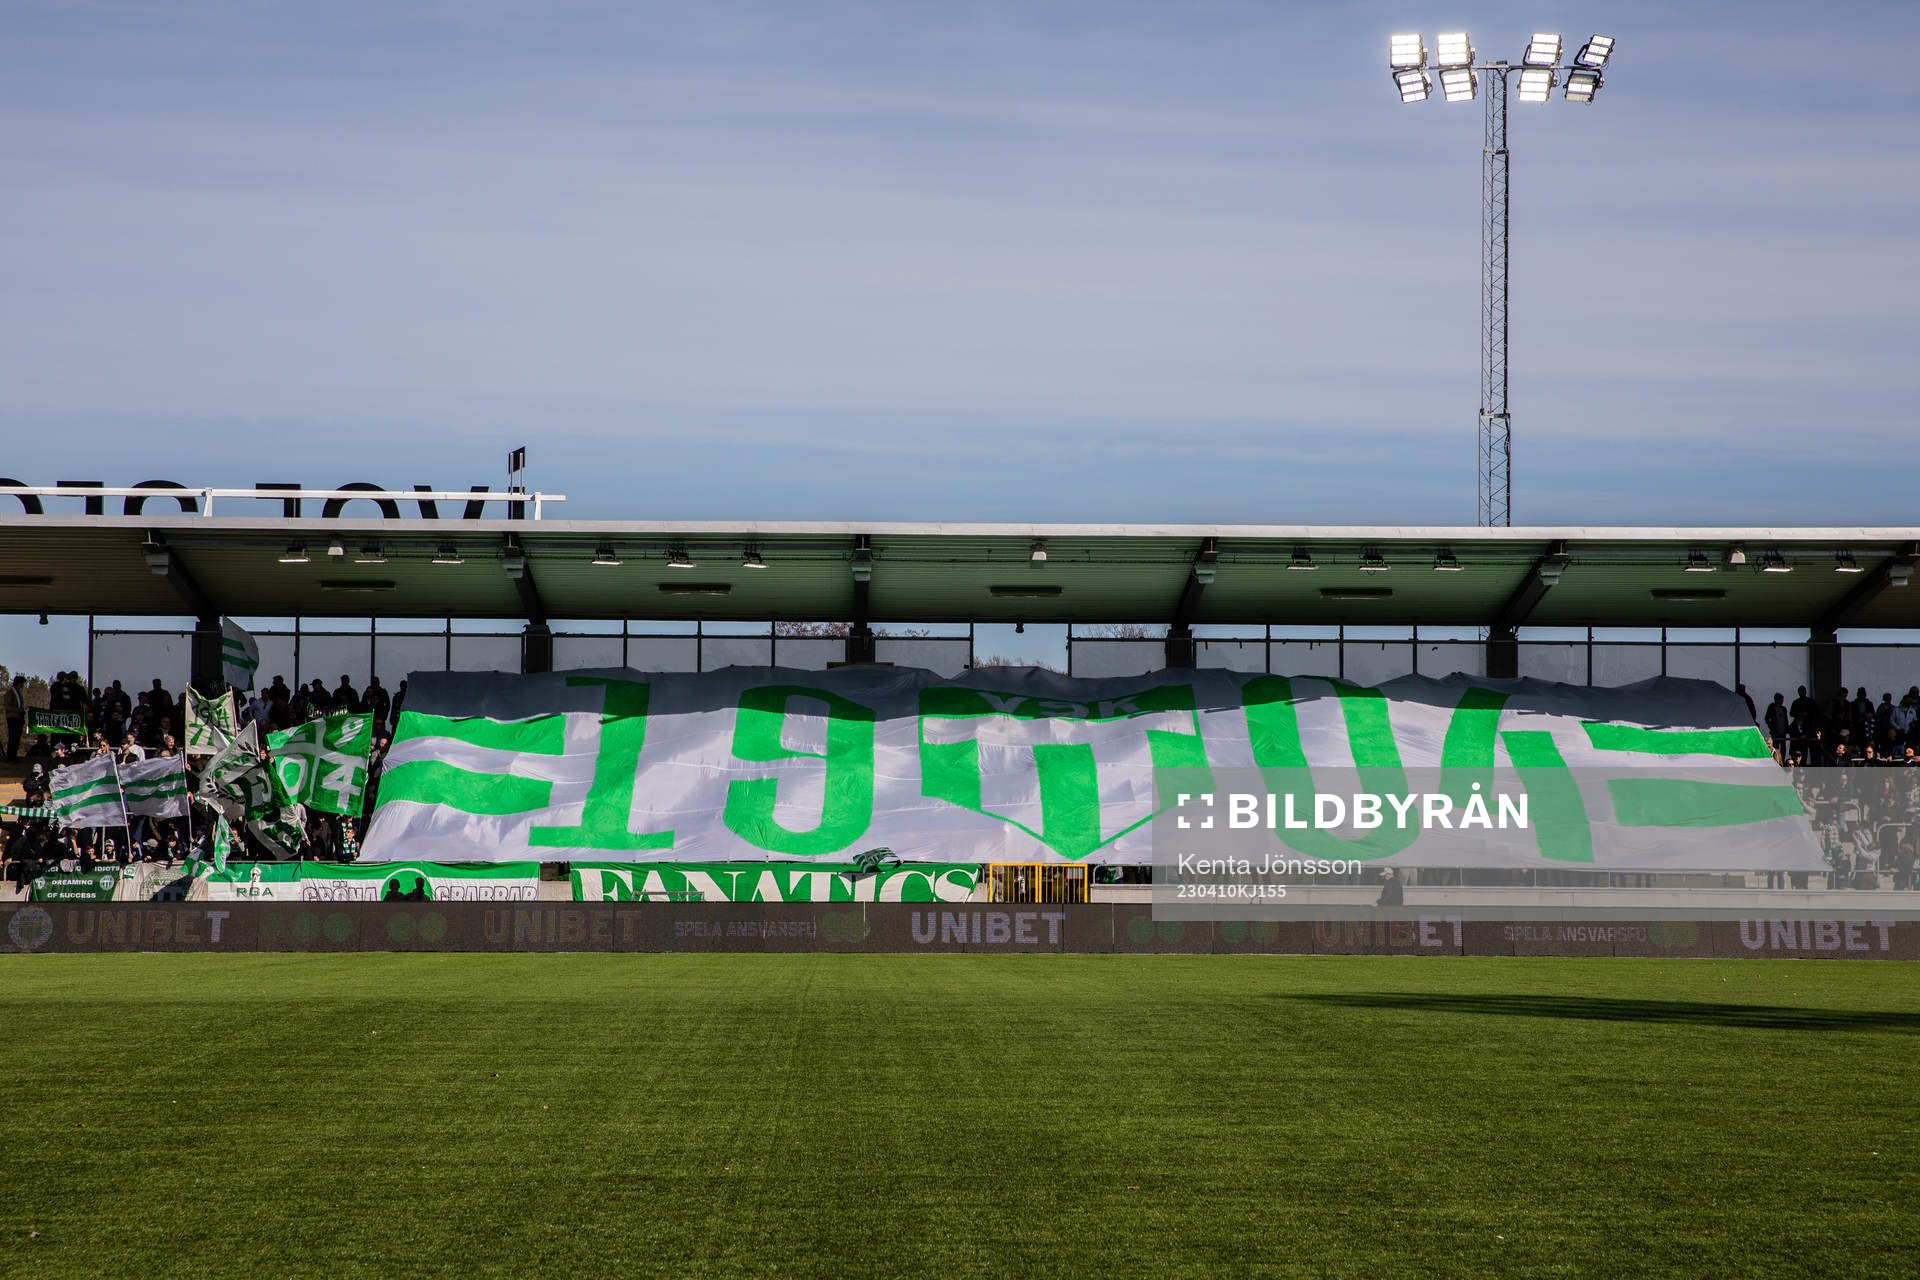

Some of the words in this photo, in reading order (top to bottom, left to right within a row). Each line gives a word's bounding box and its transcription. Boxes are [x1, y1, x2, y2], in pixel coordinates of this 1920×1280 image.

[976, 692, 1141, 718] VSK
[236, 887, 274, 897] RGA
[571, 868, 980, 902] FANATICS
[66, 911, 230, 944] UNIBET
[484, 910, 643, 944] UNIBET
[674, 921, 722, 937] SPELA
[911, 912, 1066, 944] UNIBET
[1314, 914, 1465, 947] UNIBET
[1739, 918, 1896, 951] UNIBET
